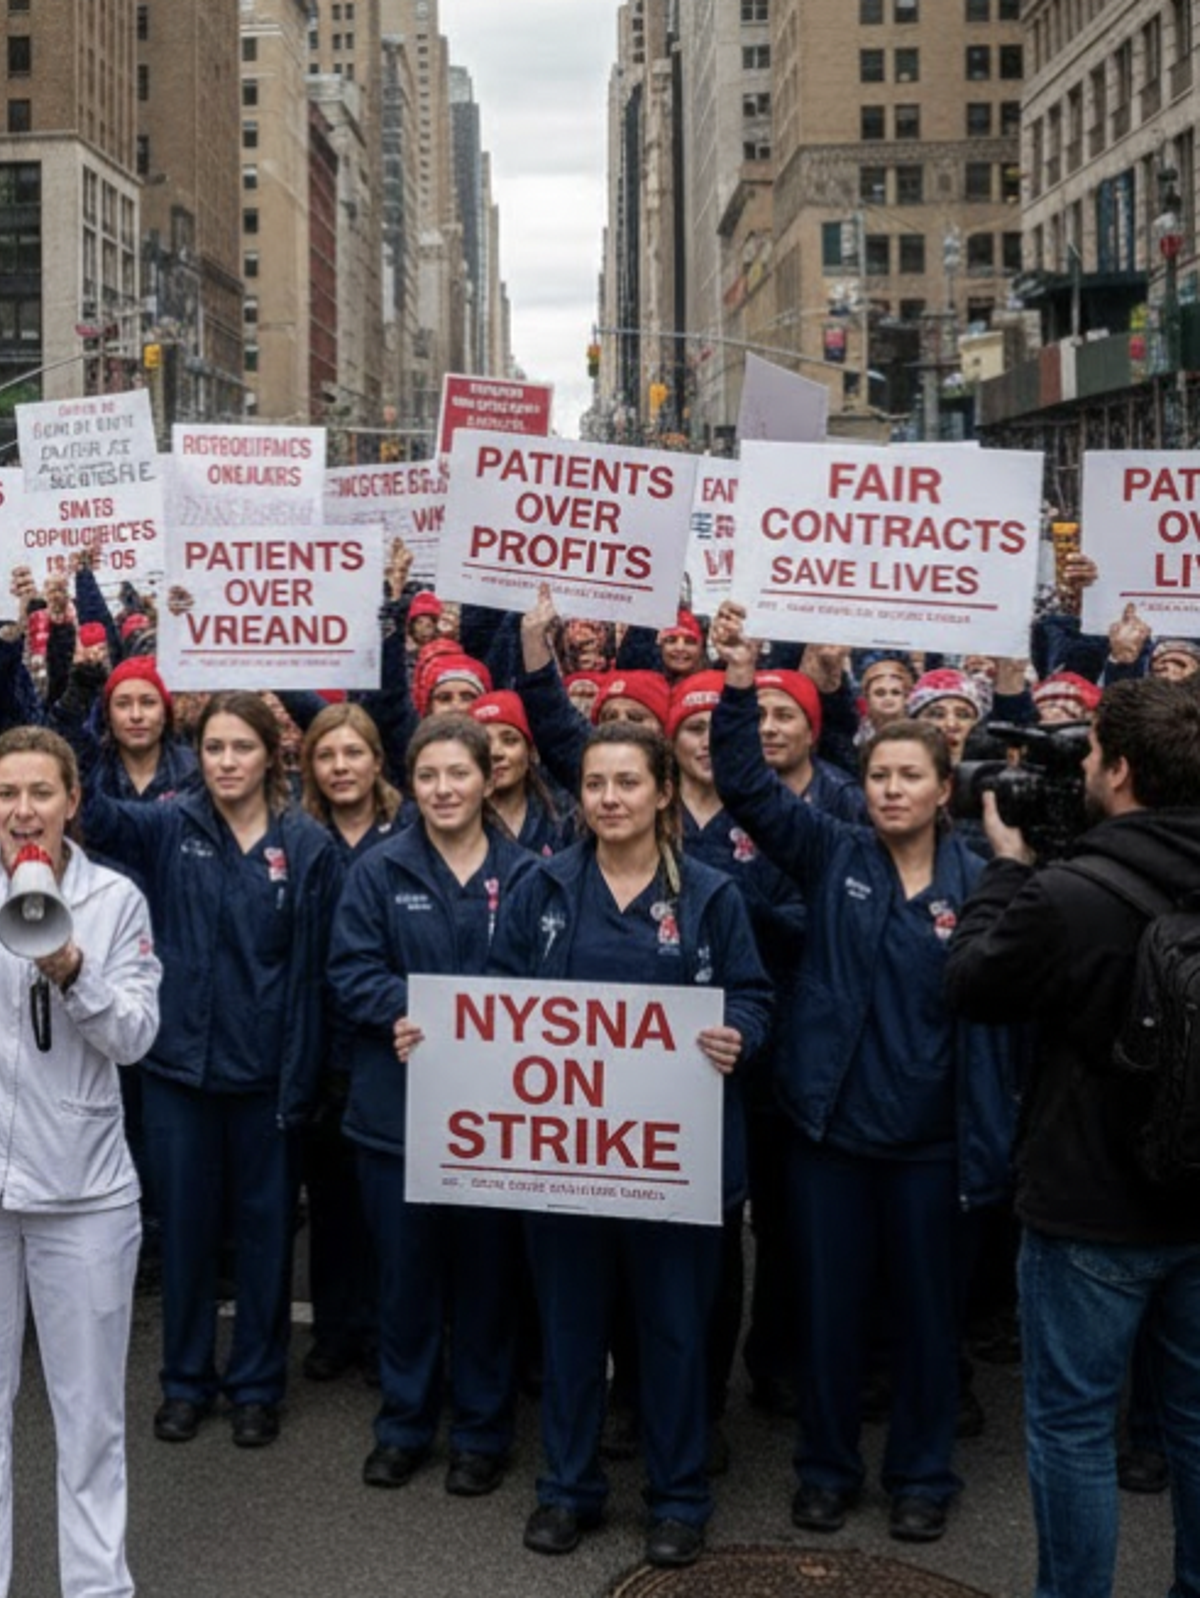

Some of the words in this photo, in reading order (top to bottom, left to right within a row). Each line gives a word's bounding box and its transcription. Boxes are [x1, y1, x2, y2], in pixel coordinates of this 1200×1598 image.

[476, 447, 673, 499] PATIENTS
[829, 463, 941, 504] FAIR
[516, 492, 620, 534] OVER
[761, 507, 1026, 554] CONTRACTS
[185, 541, 365, 572] PATIENTS
[469, 526, 652, 579] PROFITS
[225, 578, 313, 607] OVER
[771, 556, 857, 588] SAVE
[870, 562, 979, 595] LIVES
[186, 612, 348, 645] VREAND
[455, 993, 676, 1051] NYSNA
[513, 1056, 604, 1107] ON
[447, 1110, 681, 1171] STRIKE
